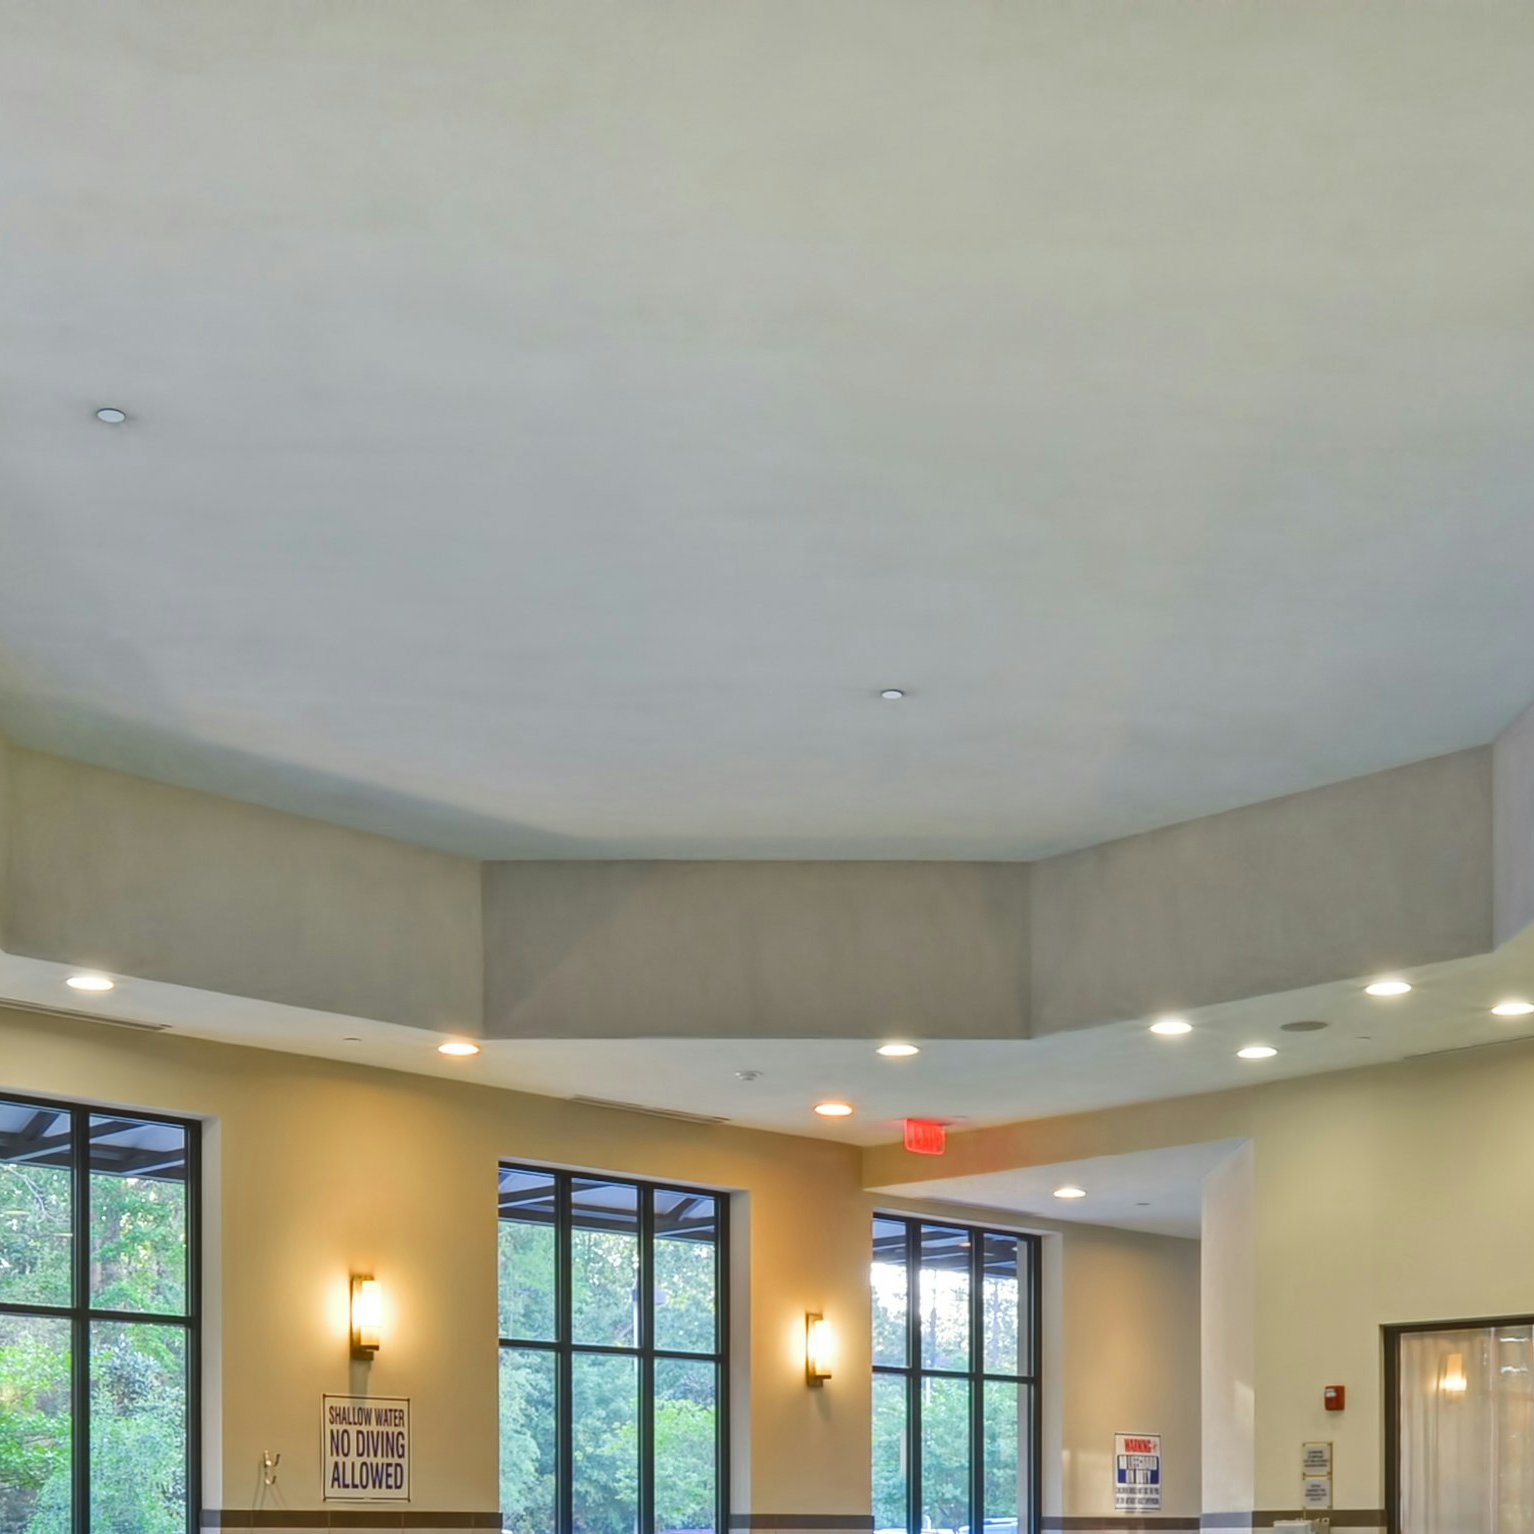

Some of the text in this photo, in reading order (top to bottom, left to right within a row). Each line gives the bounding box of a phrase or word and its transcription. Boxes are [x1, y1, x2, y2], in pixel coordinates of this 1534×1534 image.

[329, 1406, 405, 1427] SHALLOW WATER
[330, 1429, 405, 1459] NO DIVING
[331, 1461, 404, 1490] ALLOWED
